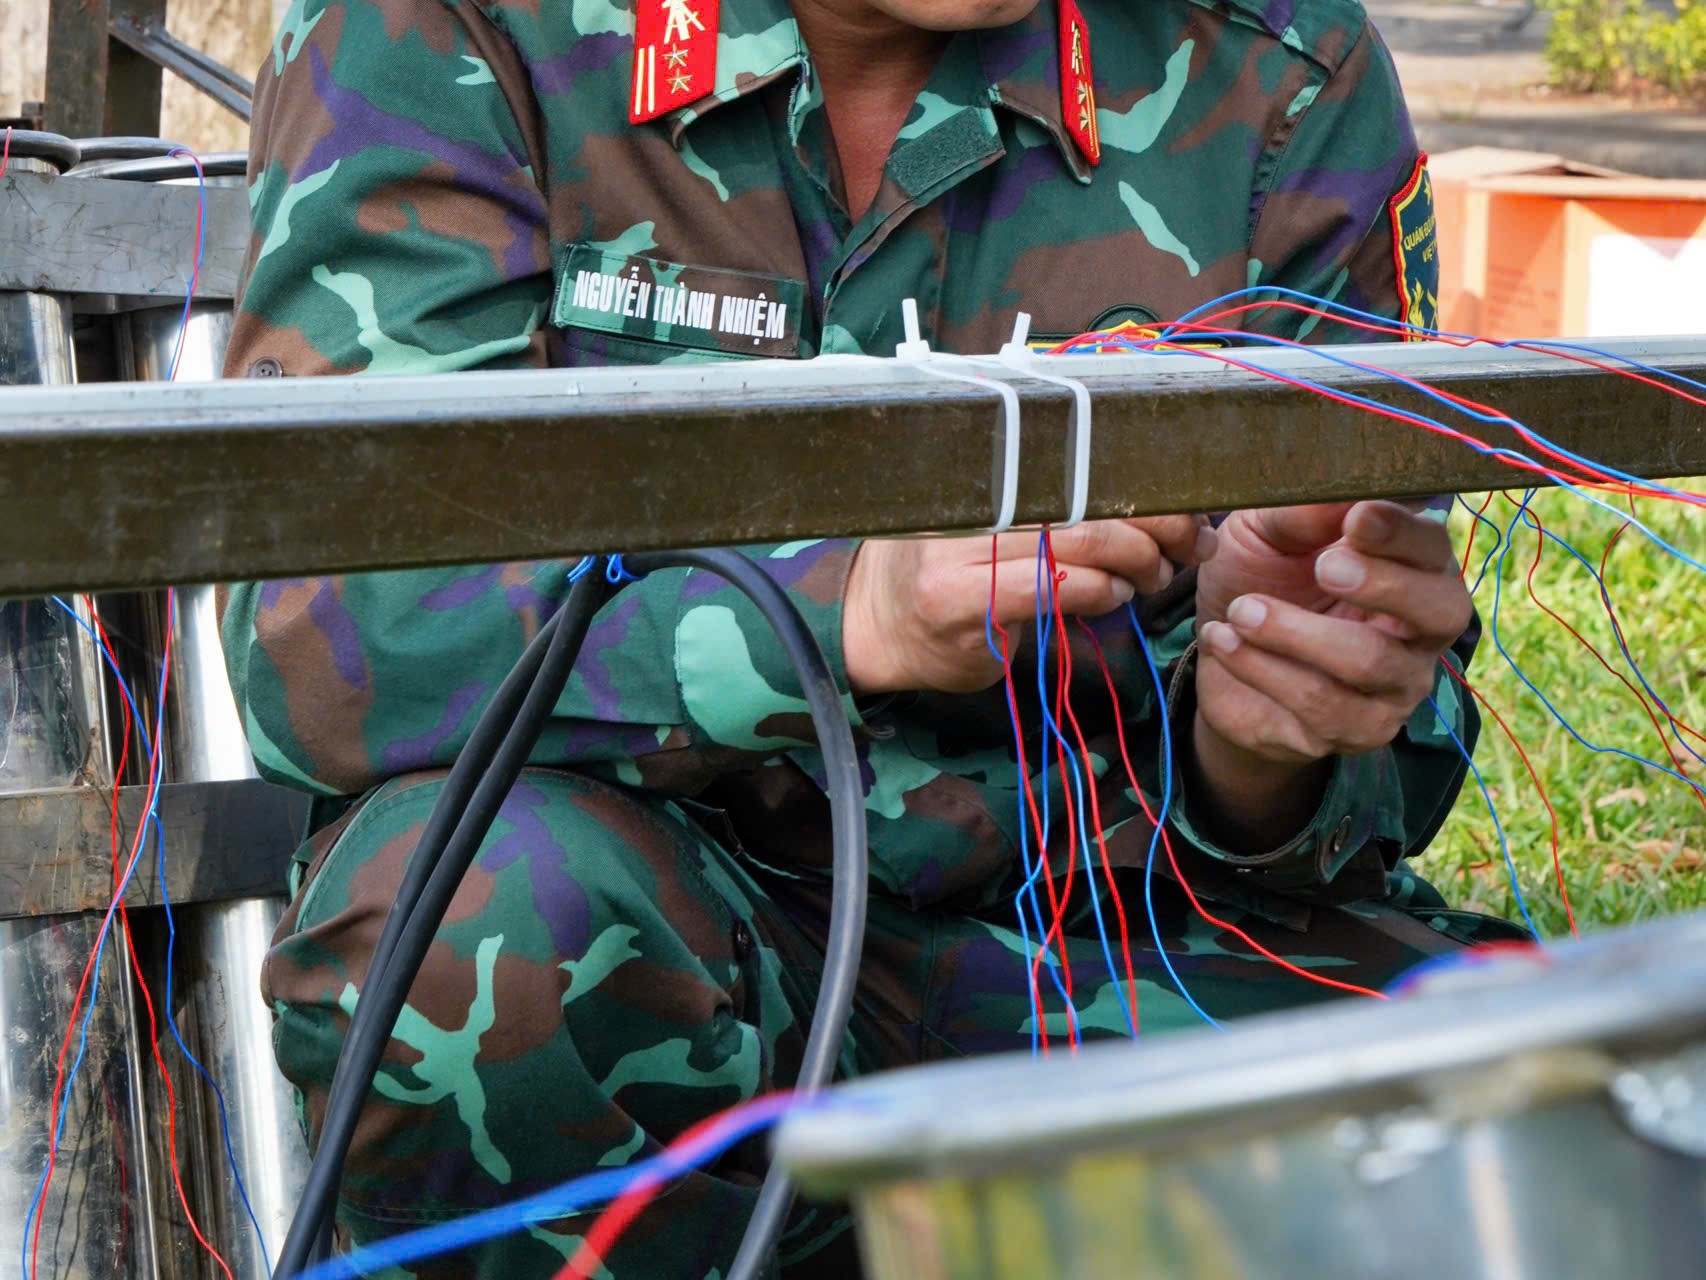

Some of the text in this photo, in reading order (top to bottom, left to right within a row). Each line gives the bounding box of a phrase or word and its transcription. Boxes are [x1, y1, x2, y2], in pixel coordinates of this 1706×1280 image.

[572, 266, 787, 345] NGUYỄN THÀNH NHIỆM
